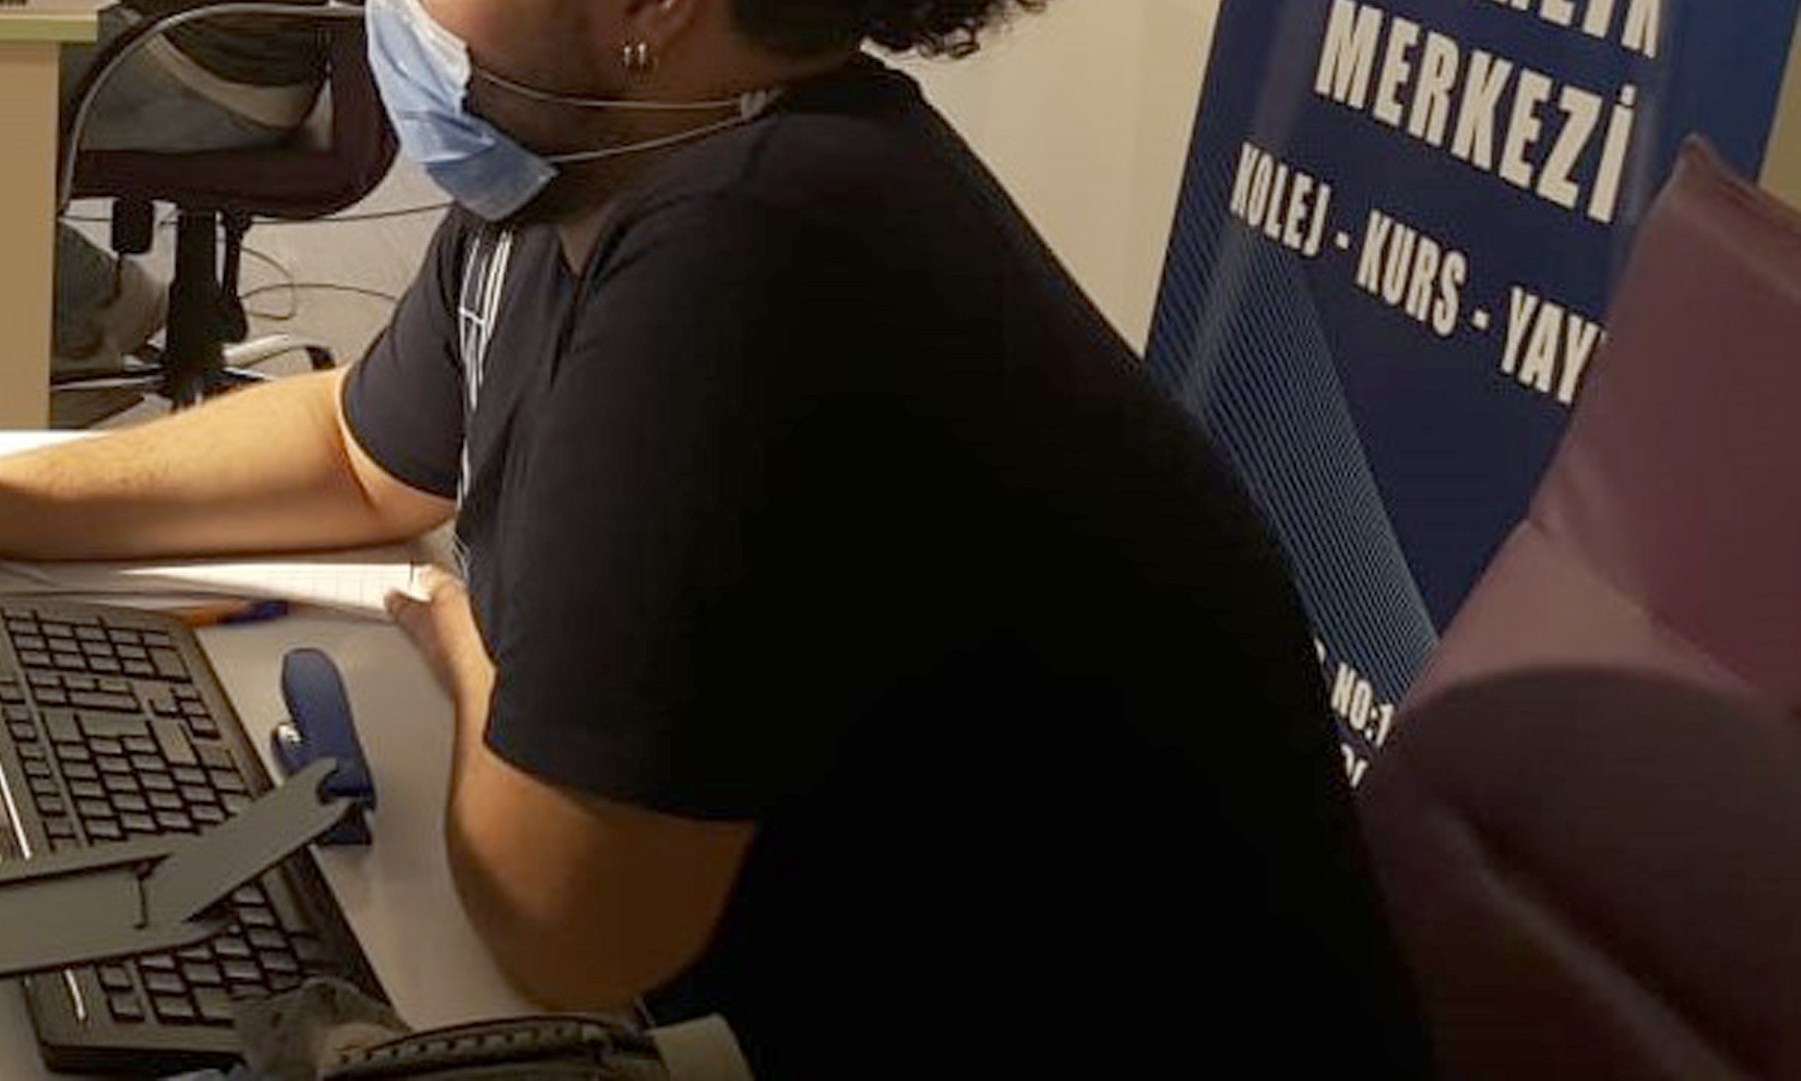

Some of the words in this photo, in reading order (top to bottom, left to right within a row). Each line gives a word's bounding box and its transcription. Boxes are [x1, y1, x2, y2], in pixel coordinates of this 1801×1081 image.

[1229, 142, 1331, 257] KOLEJ
[1356, 209, 1467, 336] KURS
[1501, 286, 1607, 405] YAY
